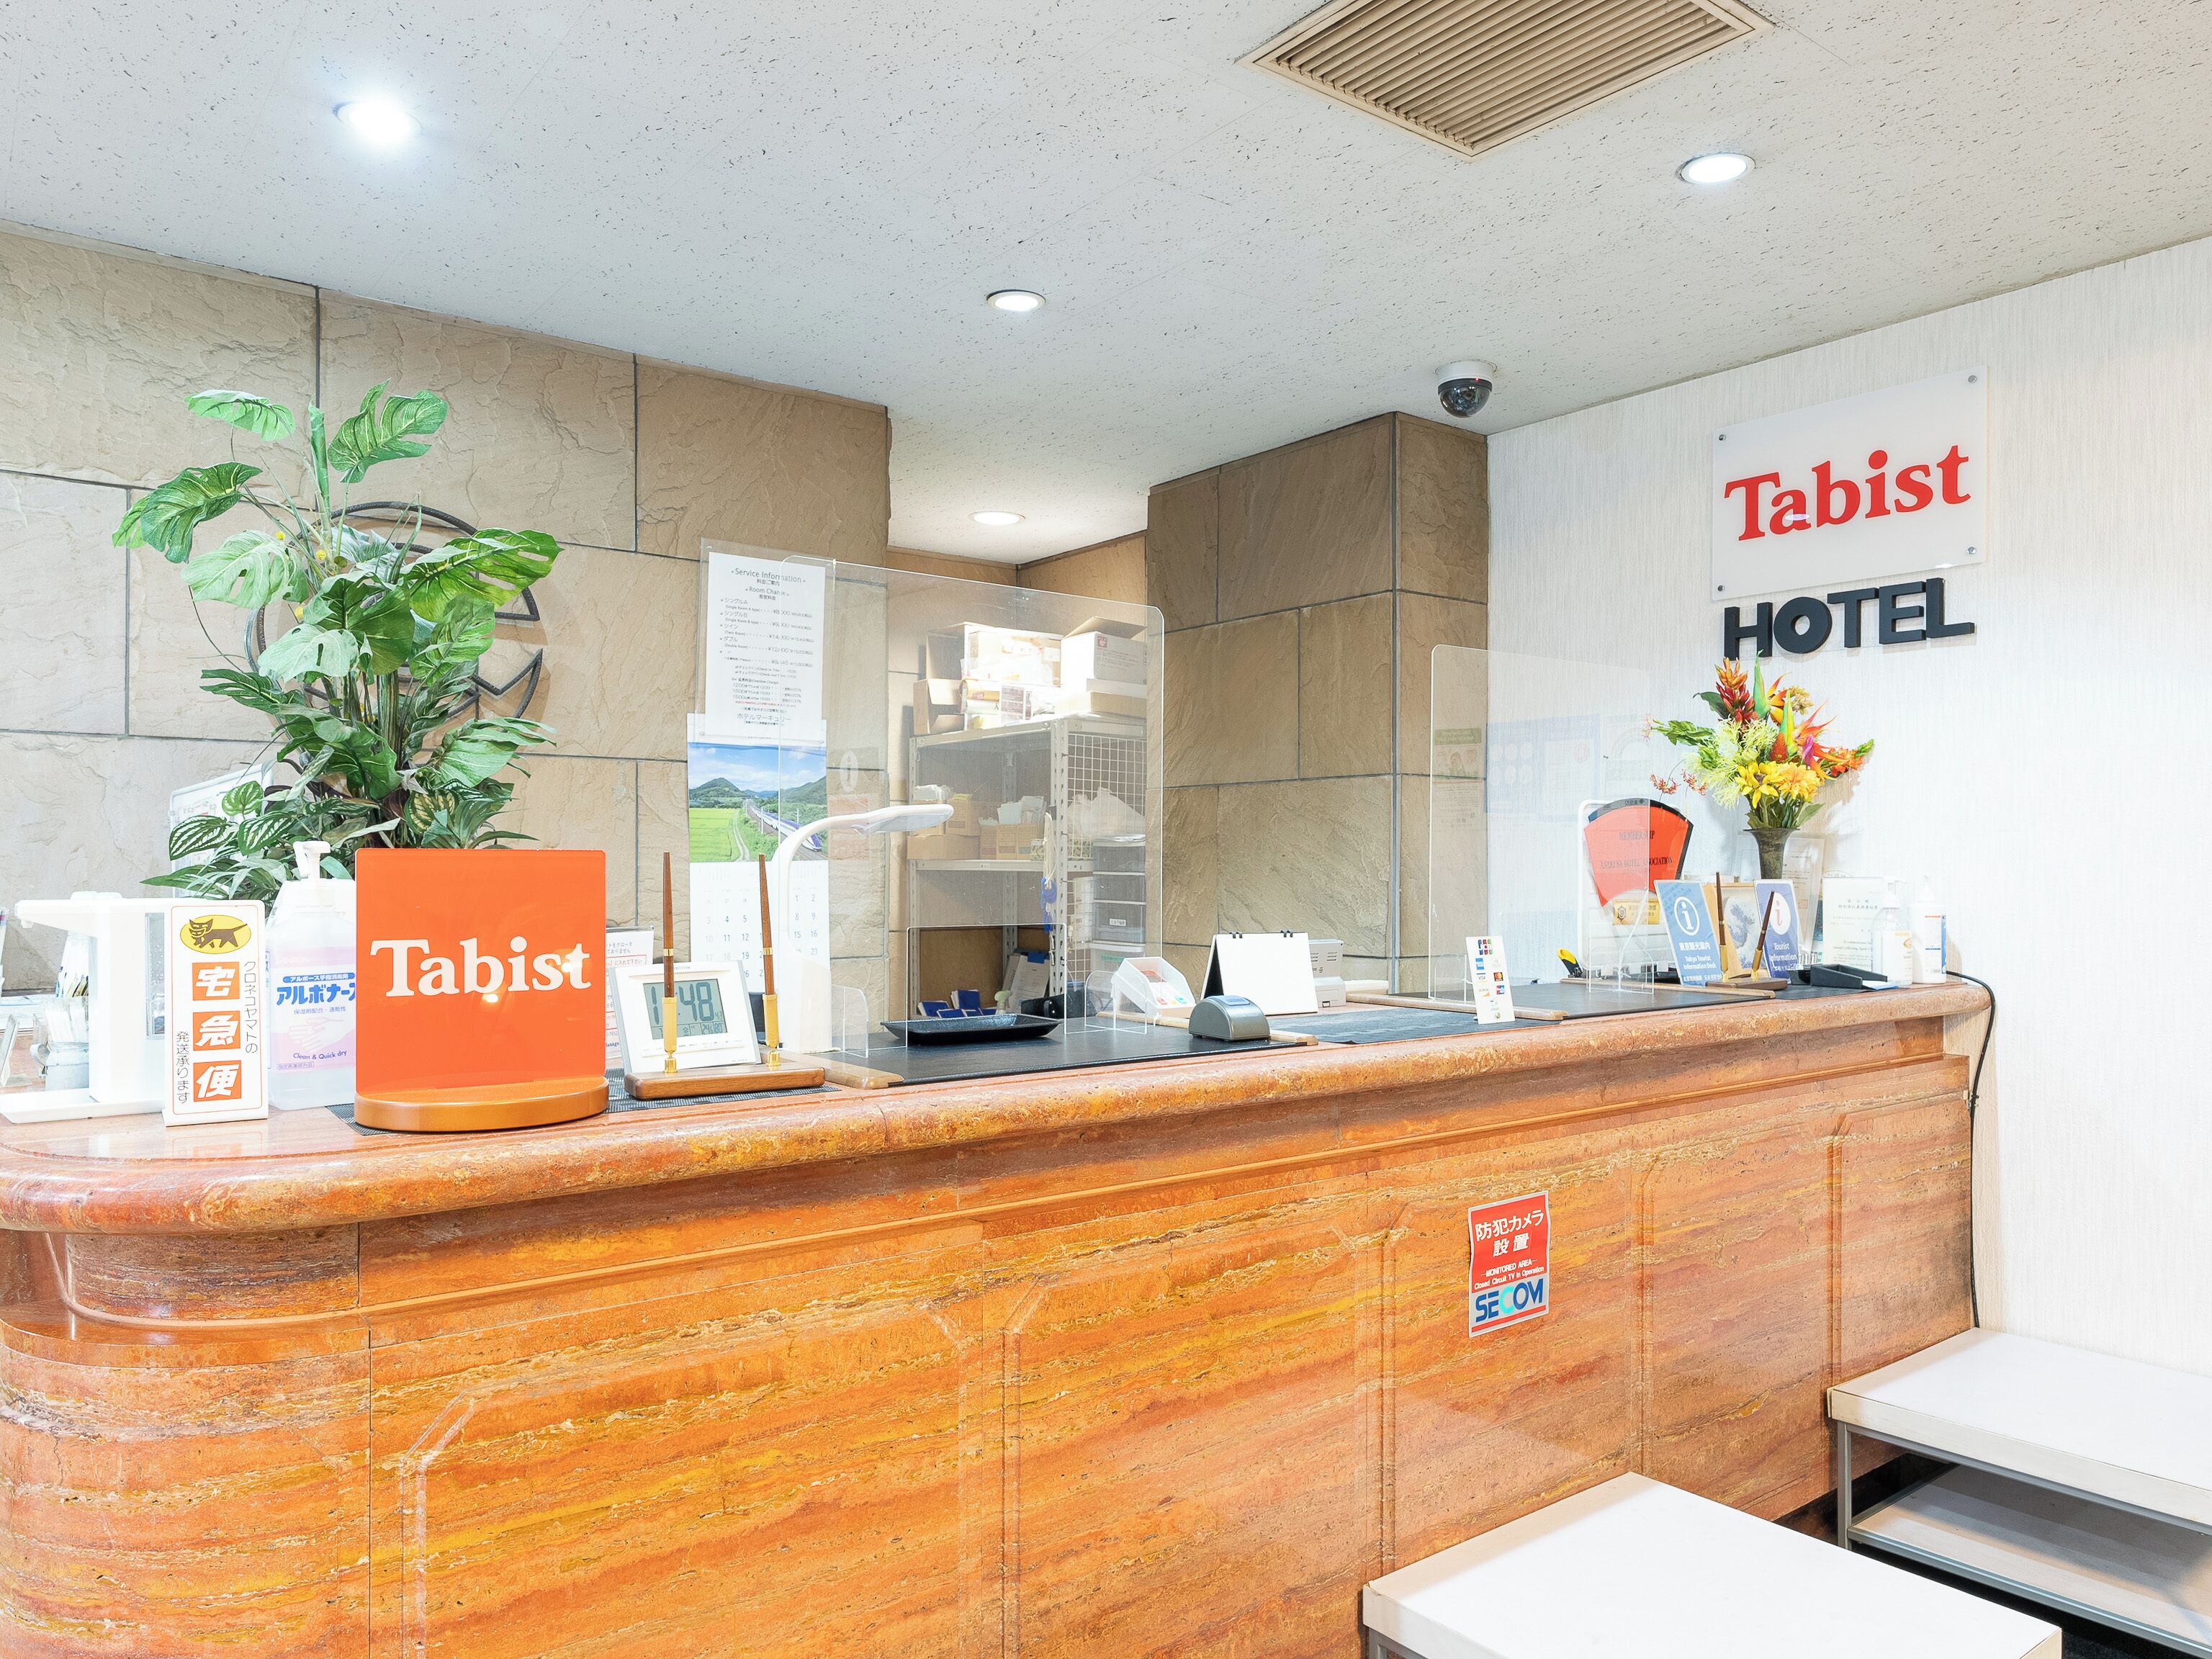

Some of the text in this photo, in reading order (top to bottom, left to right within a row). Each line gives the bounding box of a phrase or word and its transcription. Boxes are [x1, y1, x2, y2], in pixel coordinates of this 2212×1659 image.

[1724, 445, 1972, 541] Tabist
[734, 567, 760, 578] Service
[1723, 577, 1975, 660] HOTEL
[737, 713, 791, 722] ホテルマーキュリー
[1769, 953, 1797, 962] Information
[1773, 942, 1789, 950] Tourist
[369, 935, 592, 997] Tabist
[243, 961, 258, 1053] クロネコヤマトの
[650, 982, 714, 1025] 1:48
[195, 966, 240, 1099] 宅急便
[176, 1030, 190, 1104] 発送承ります
[337, 1050, 347, 1058] dry
[1475, 1209, 1544, 1242] 防犯カメラ
[1493, 1232, 1529, 1257] 設置
[1474, 1280, 1491, 1290] Closed
[1492, 1275, 1507, 1285] Circuit
[1521, 1266, 1545, 1277] Operation
[1518, 1258, 1532, 1269] AREA
[1475, 1278, 1544, 1323] SECOM
